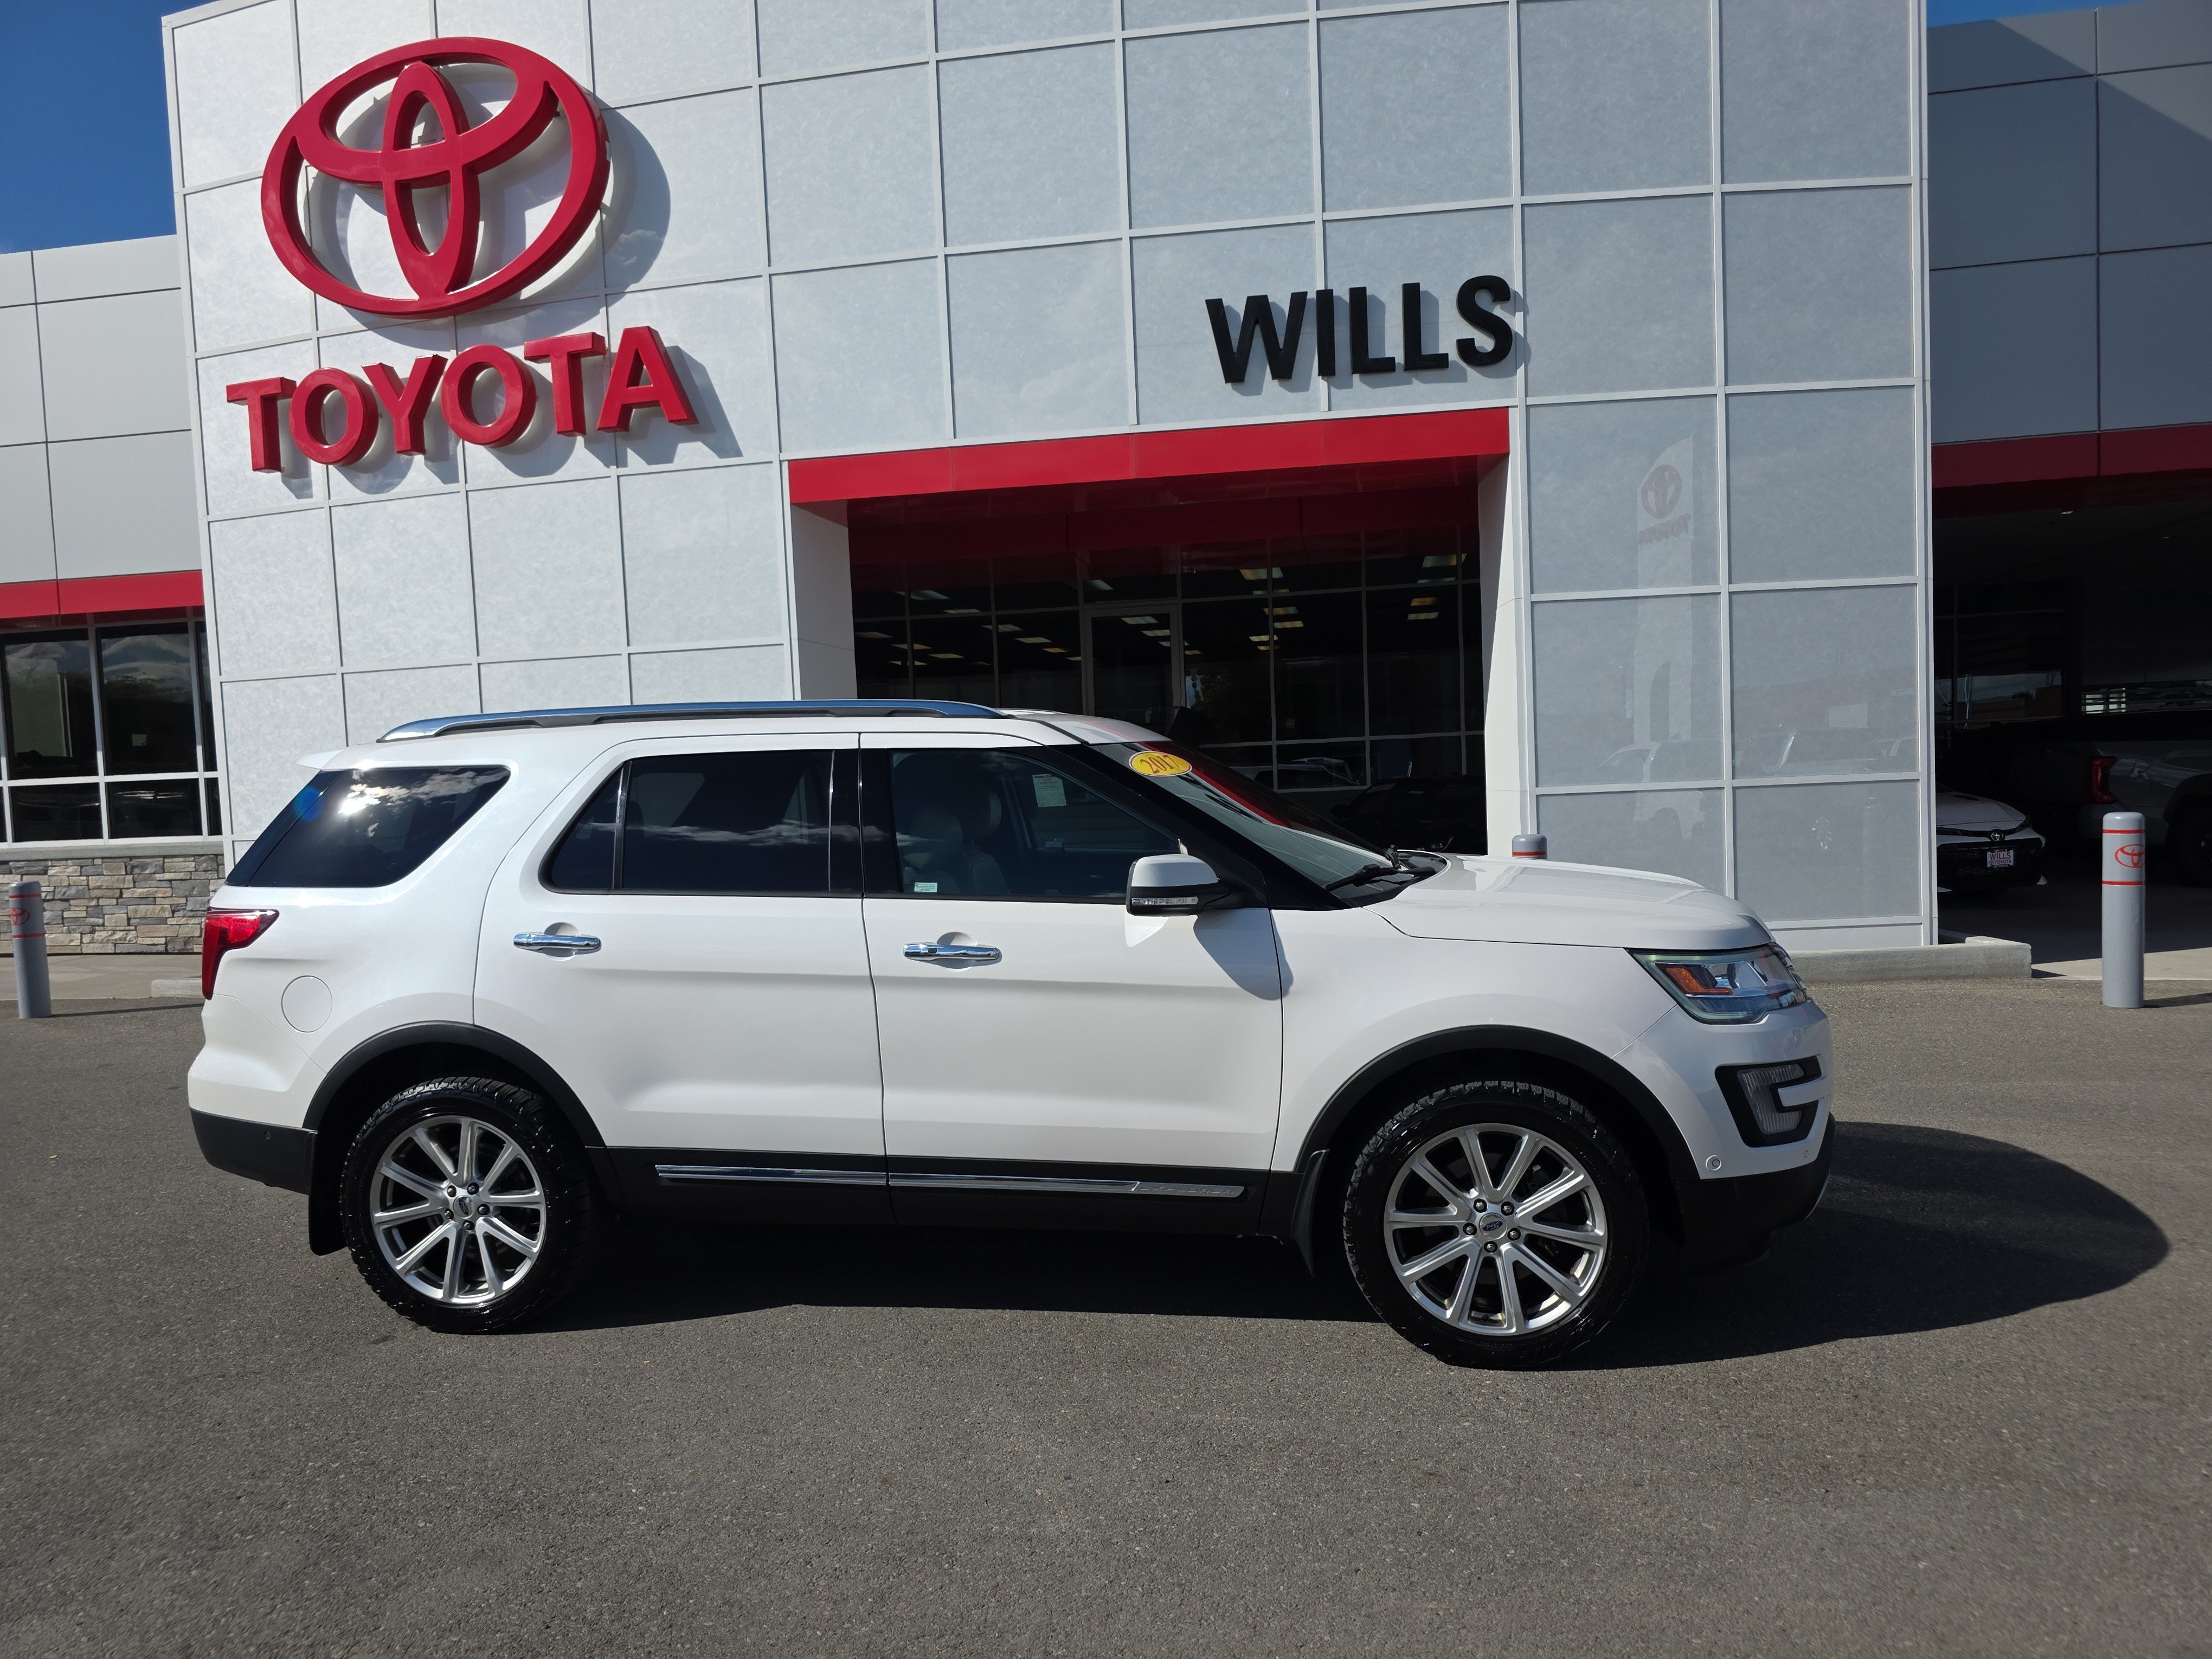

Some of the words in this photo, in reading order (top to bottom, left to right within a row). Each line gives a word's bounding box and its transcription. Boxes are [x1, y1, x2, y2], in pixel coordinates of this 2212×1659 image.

[1205, 275, 1513, 384] WILLS
[226, 325, 699, 473] TOYOTA
[1140, 755, 1180, 774] 2017
[1990, 852, 2011, 860] WILLS
[1140, 1186, 1234, 1194] EXPLORER
